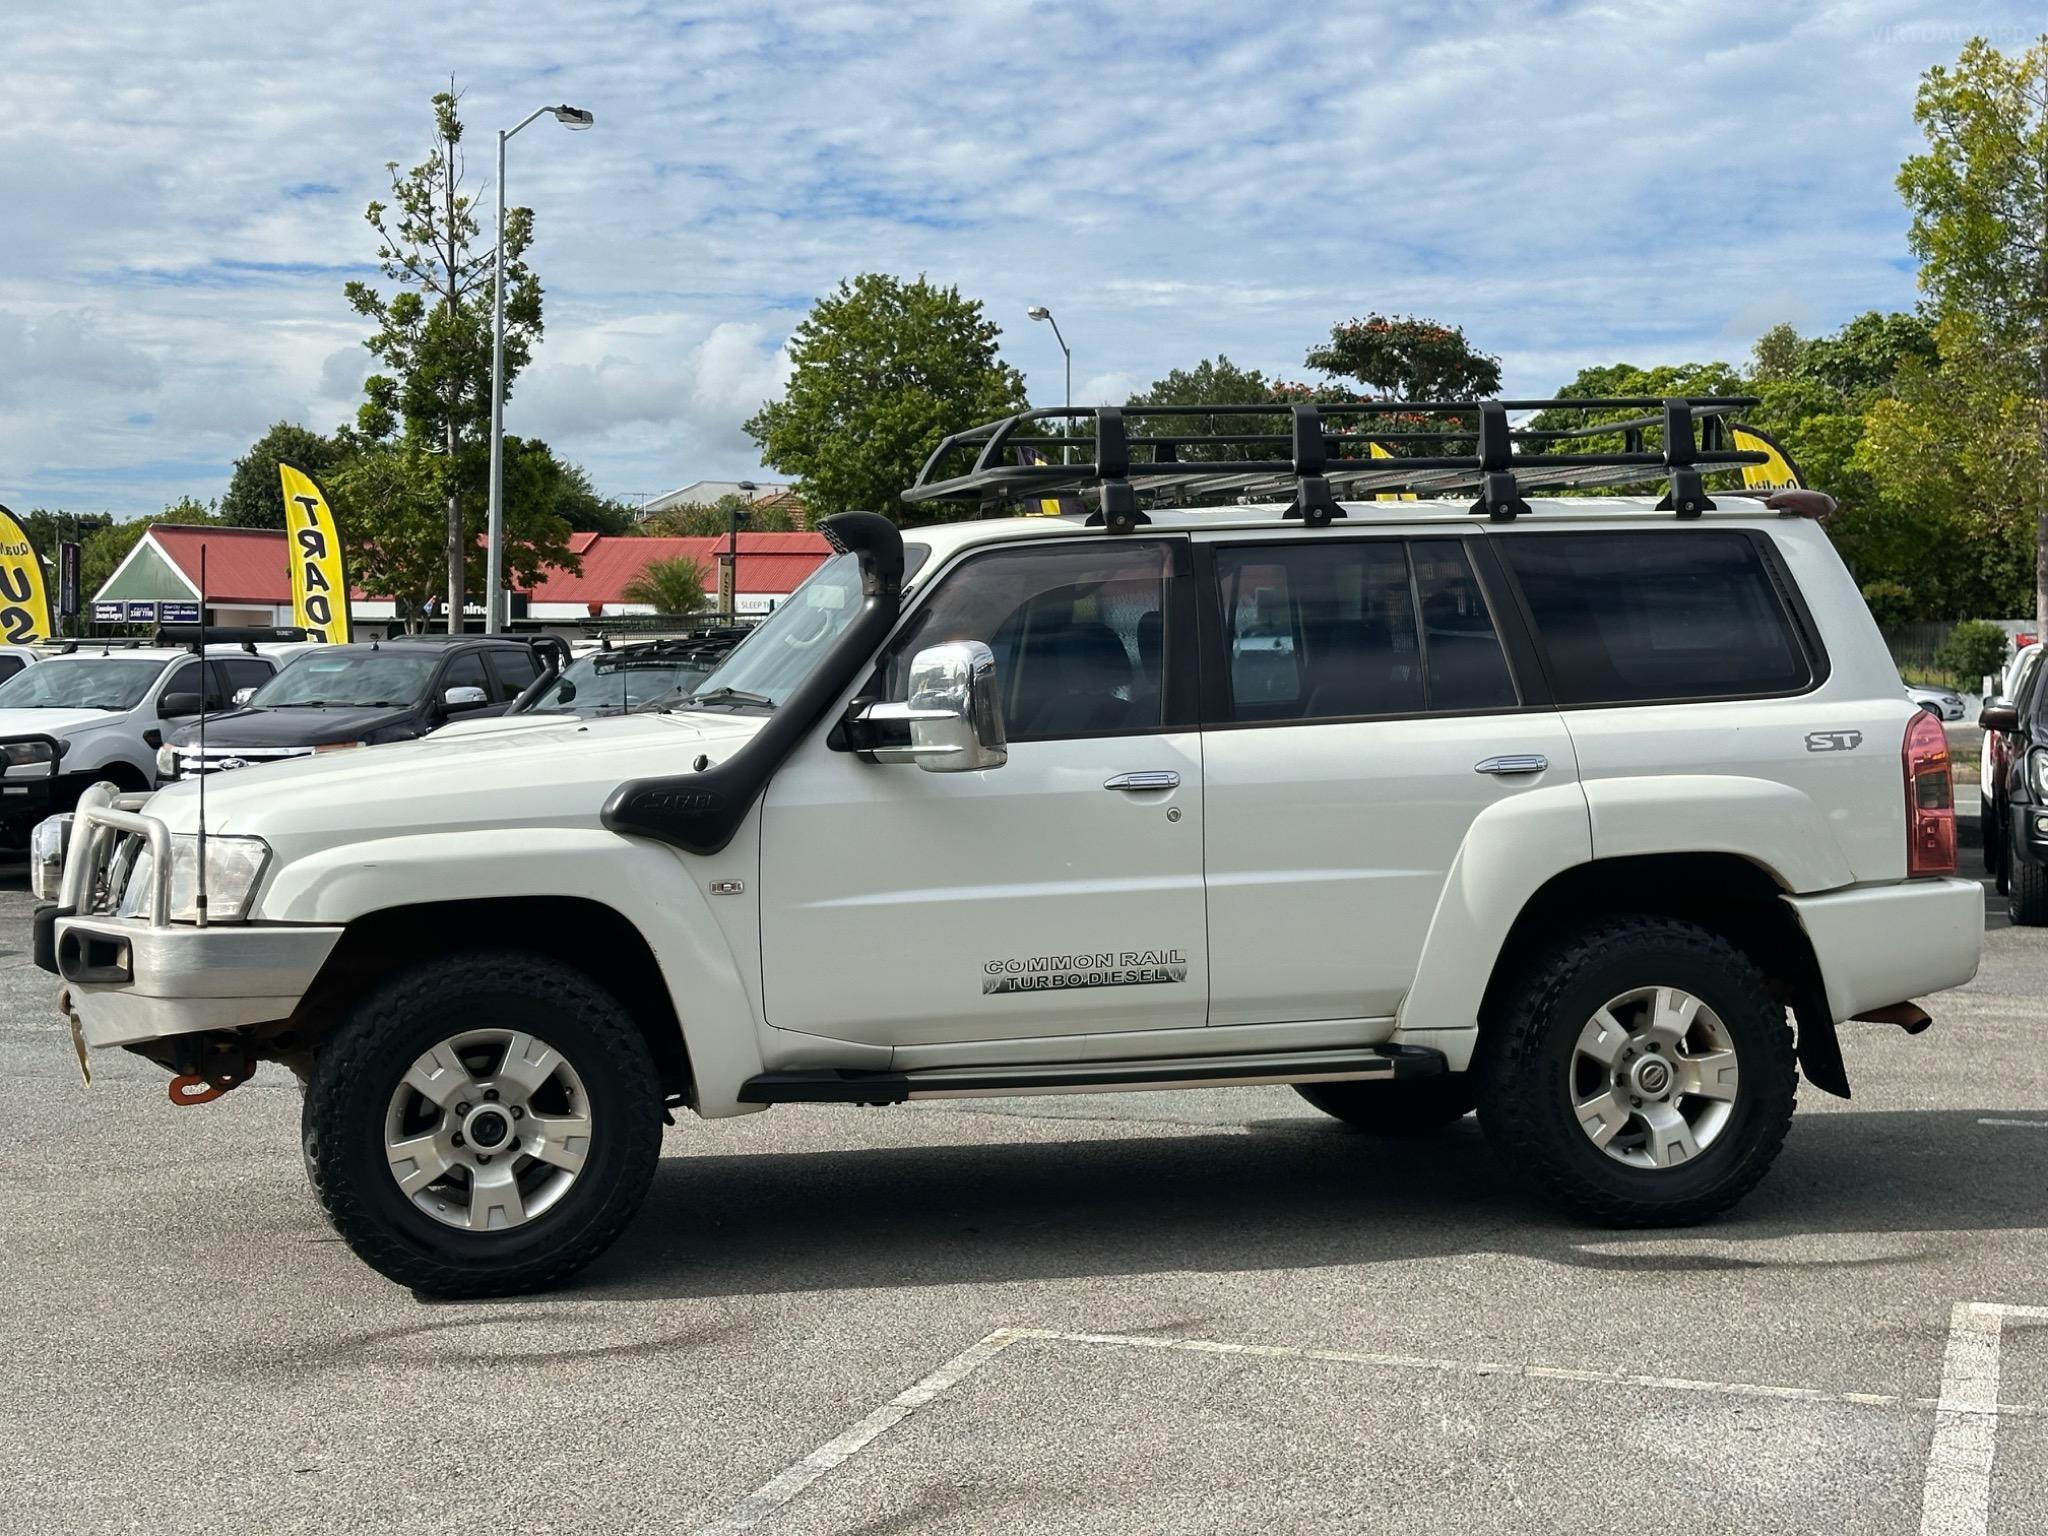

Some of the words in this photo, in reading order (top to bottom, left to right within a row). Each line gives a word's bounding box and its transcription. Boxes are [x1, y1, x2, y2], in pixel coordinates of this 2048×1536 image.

[441, 602, 488, 615] Dmino
[741, 601, 761, 609] SLEEP
[1808, 731, 1860, 751] ST
[983, 953, 1114, 975] COMMON
[1119, 949, 1187, 967] RAIL
[1006, 972, 1083, 991] TURBO
[1087, 968, 1168, 986] DIESEL
